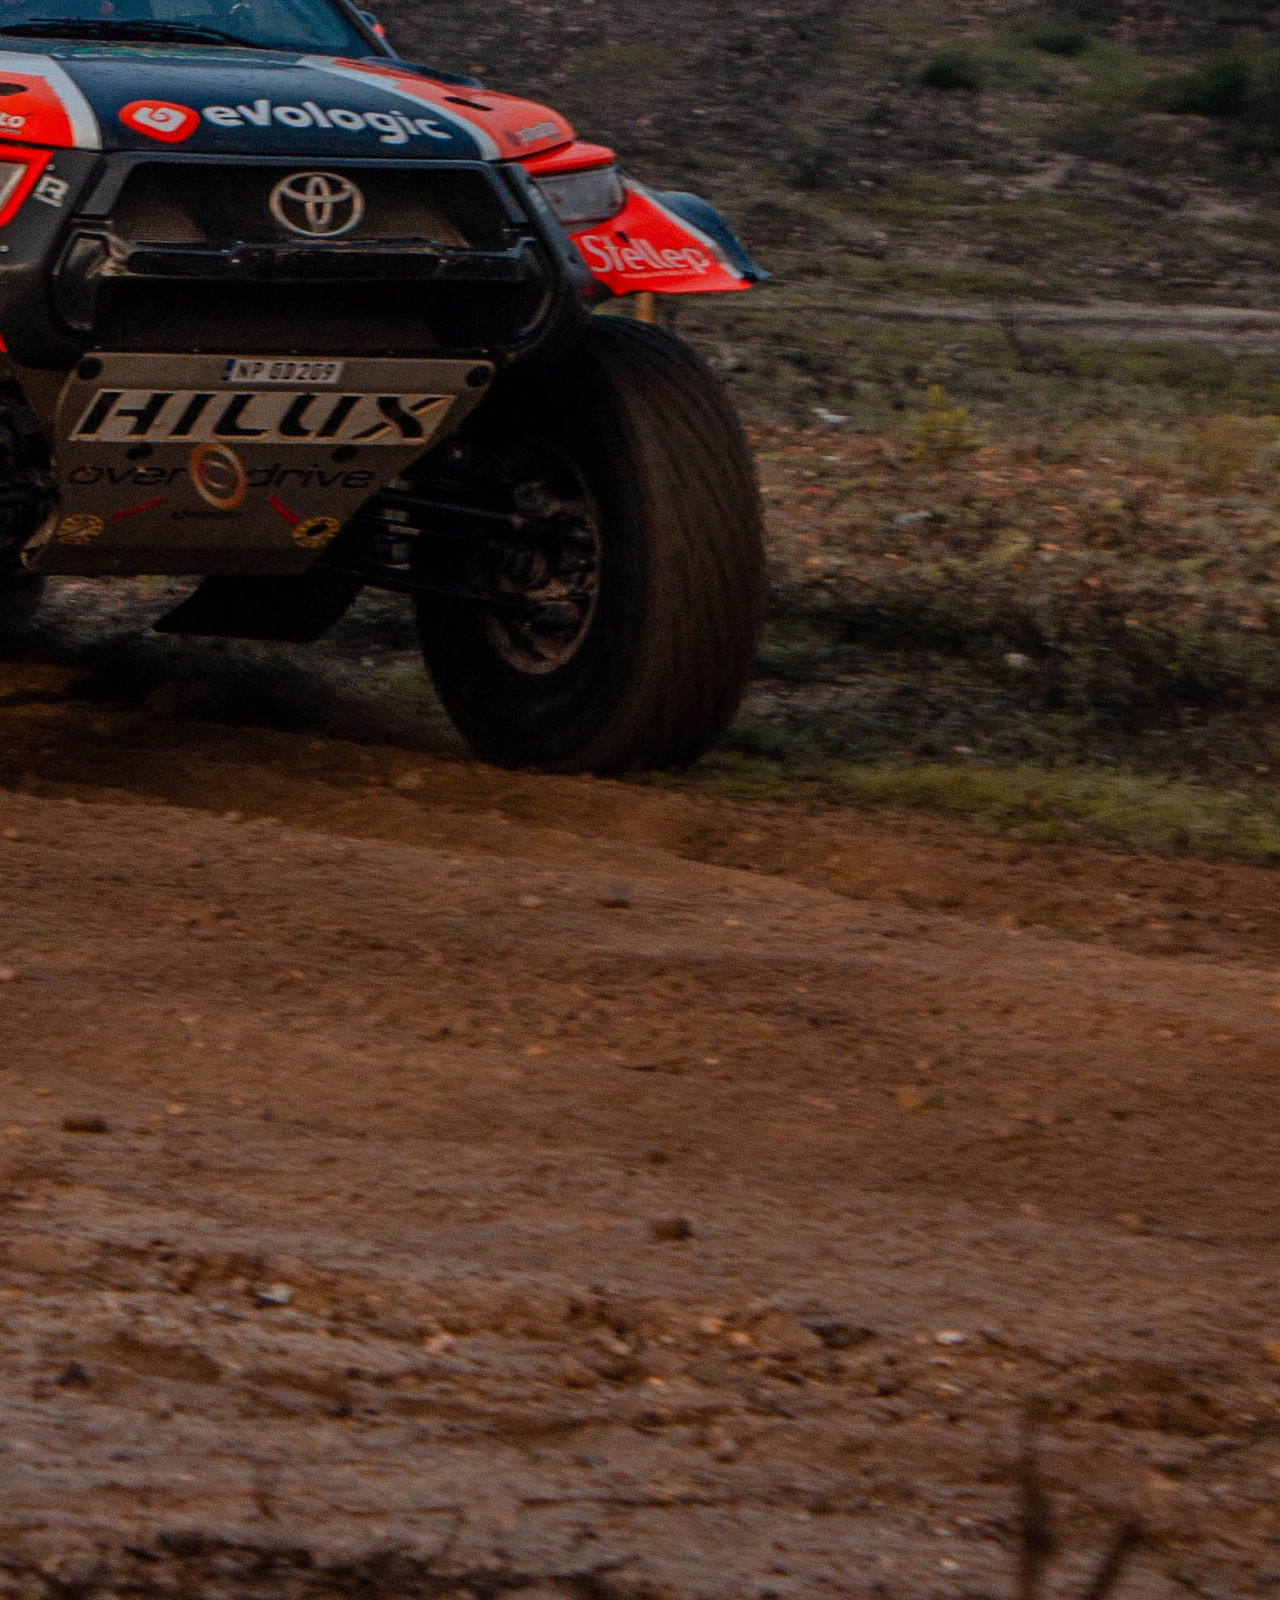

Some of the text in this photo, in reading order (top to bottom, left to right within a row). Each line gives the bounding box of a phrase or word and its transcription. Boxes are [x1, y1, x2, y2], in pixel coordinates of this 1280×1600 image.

[200, 99, 453, 146] evologic
[580, 234, 712, 276] Stellep
[77, 392, 454, 440] HILUX
[68, 463, 377, 489] over drive
